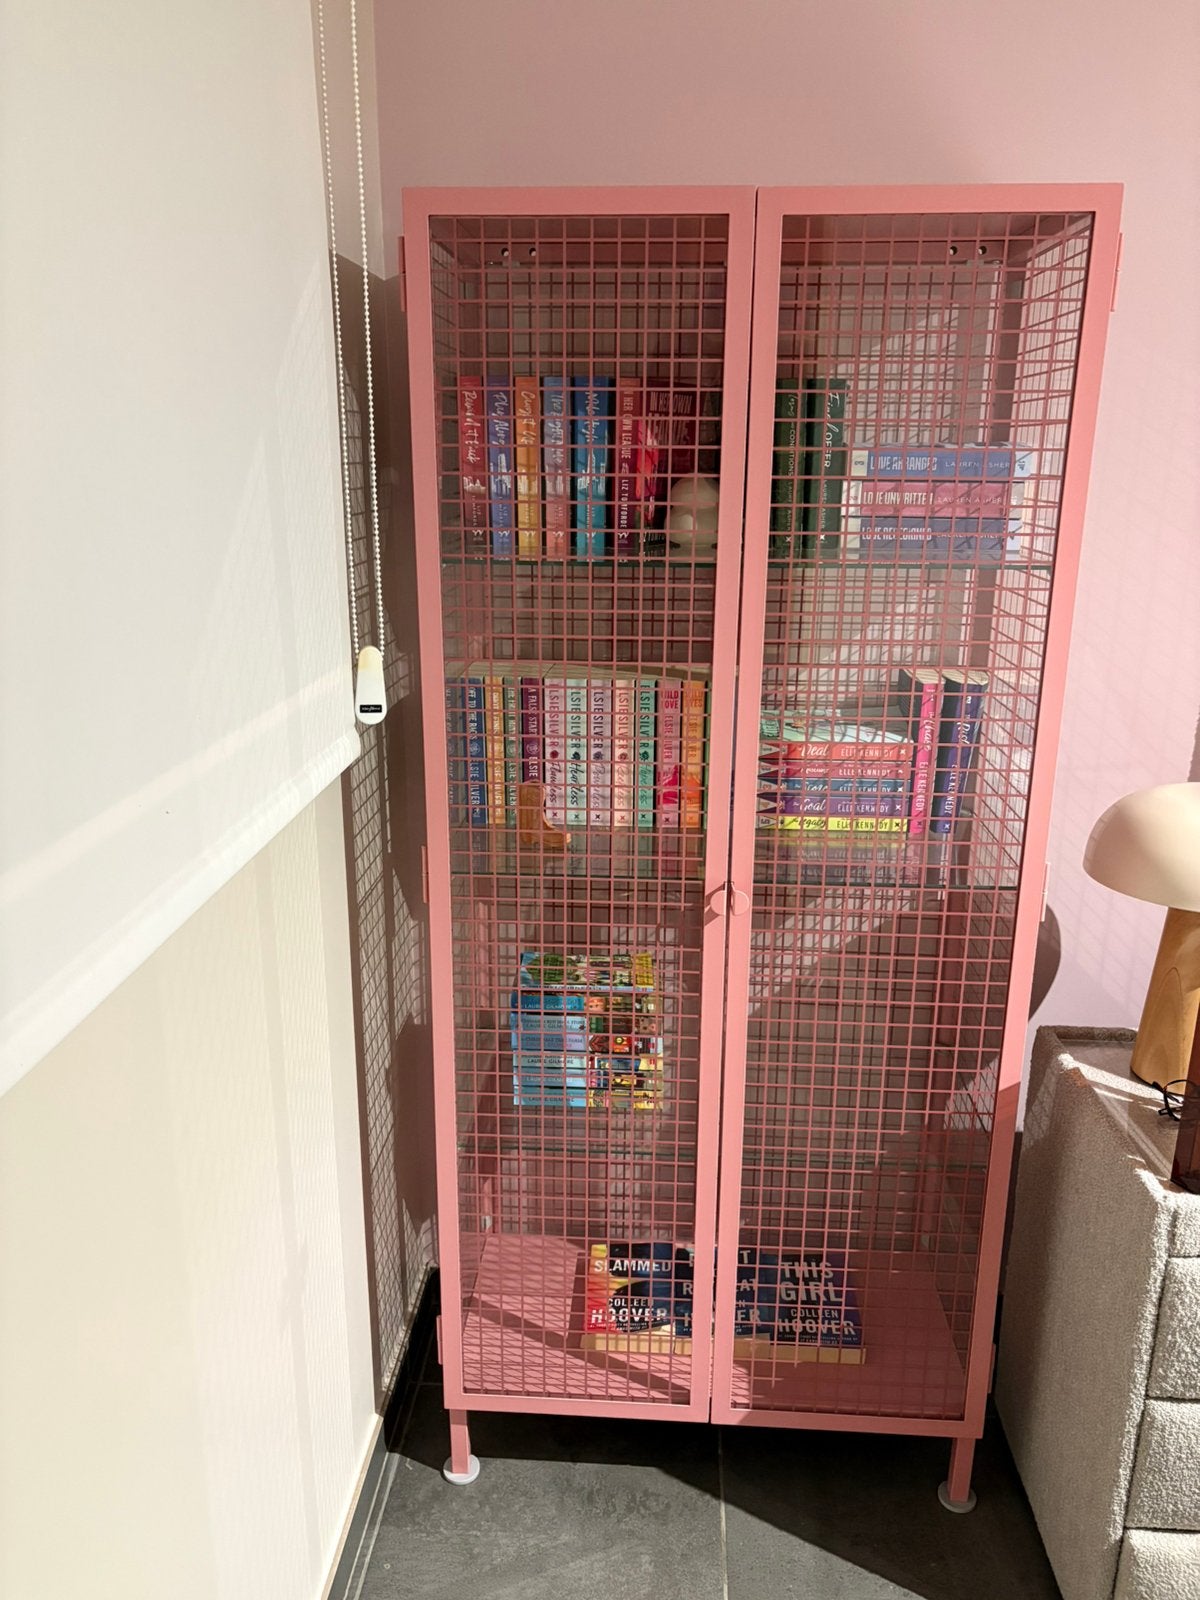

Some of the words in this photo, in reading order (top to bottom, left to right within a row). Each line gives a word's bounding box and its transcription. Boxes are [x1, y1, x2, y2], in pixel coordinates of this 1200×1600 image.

[492, 392, 508, 417] Play
[623, 397, 633, 411] HER
[622, 414, 633, 430] OWN
[492, 420, 509, 446] Along
[788, 430, 796, 476] CONITIONS
[892, 457, 937, 470] ARRANGD
[621, 480, 629, 490] LIZ
[469, 700, 477, 708] TO
[528, 696, 536, 715] FALS
[571, 687, 581, 712] LSIE
[593, 687, 604, 712] LSIE
[619, 687, 629, 713] LSIE
[640, 685, 650, 711] ELSIE
[470, 723, 478, 740] RACS
[571, 715, 581, 748] SILVER
[593, 715, 603, 748] SILVER
[619, 716, 628, 749] SILVER
[640, 715, 650, 748] SILVR
[664, 716, 673, 733] ELSIE
[664, 736, 672, 759] ILVER
[688, 736, 696, 758] SLVER
[859, 748, 893, 757] KENNDY
[470, 760, 479, 778] LSIE
[509, 761, 517, 778] LSIE
[529, 756, 538, 777] ELSIE
[950, 764, 958, 780] ELE
[471, 780, 480, 805] ILVER
[856, 805, 889, 813] KENNDY
[856, 821, 888, 830] KENNDY
[594, 1260, 672, 1272] SLAMMED
[780, 1262, 834, 1279] THIS
[780, 1282, 842, 1302] GIRL
[591, 1308, 667, 1323] HOOVER
[778, 1318, 856, 1335] HOOVER
